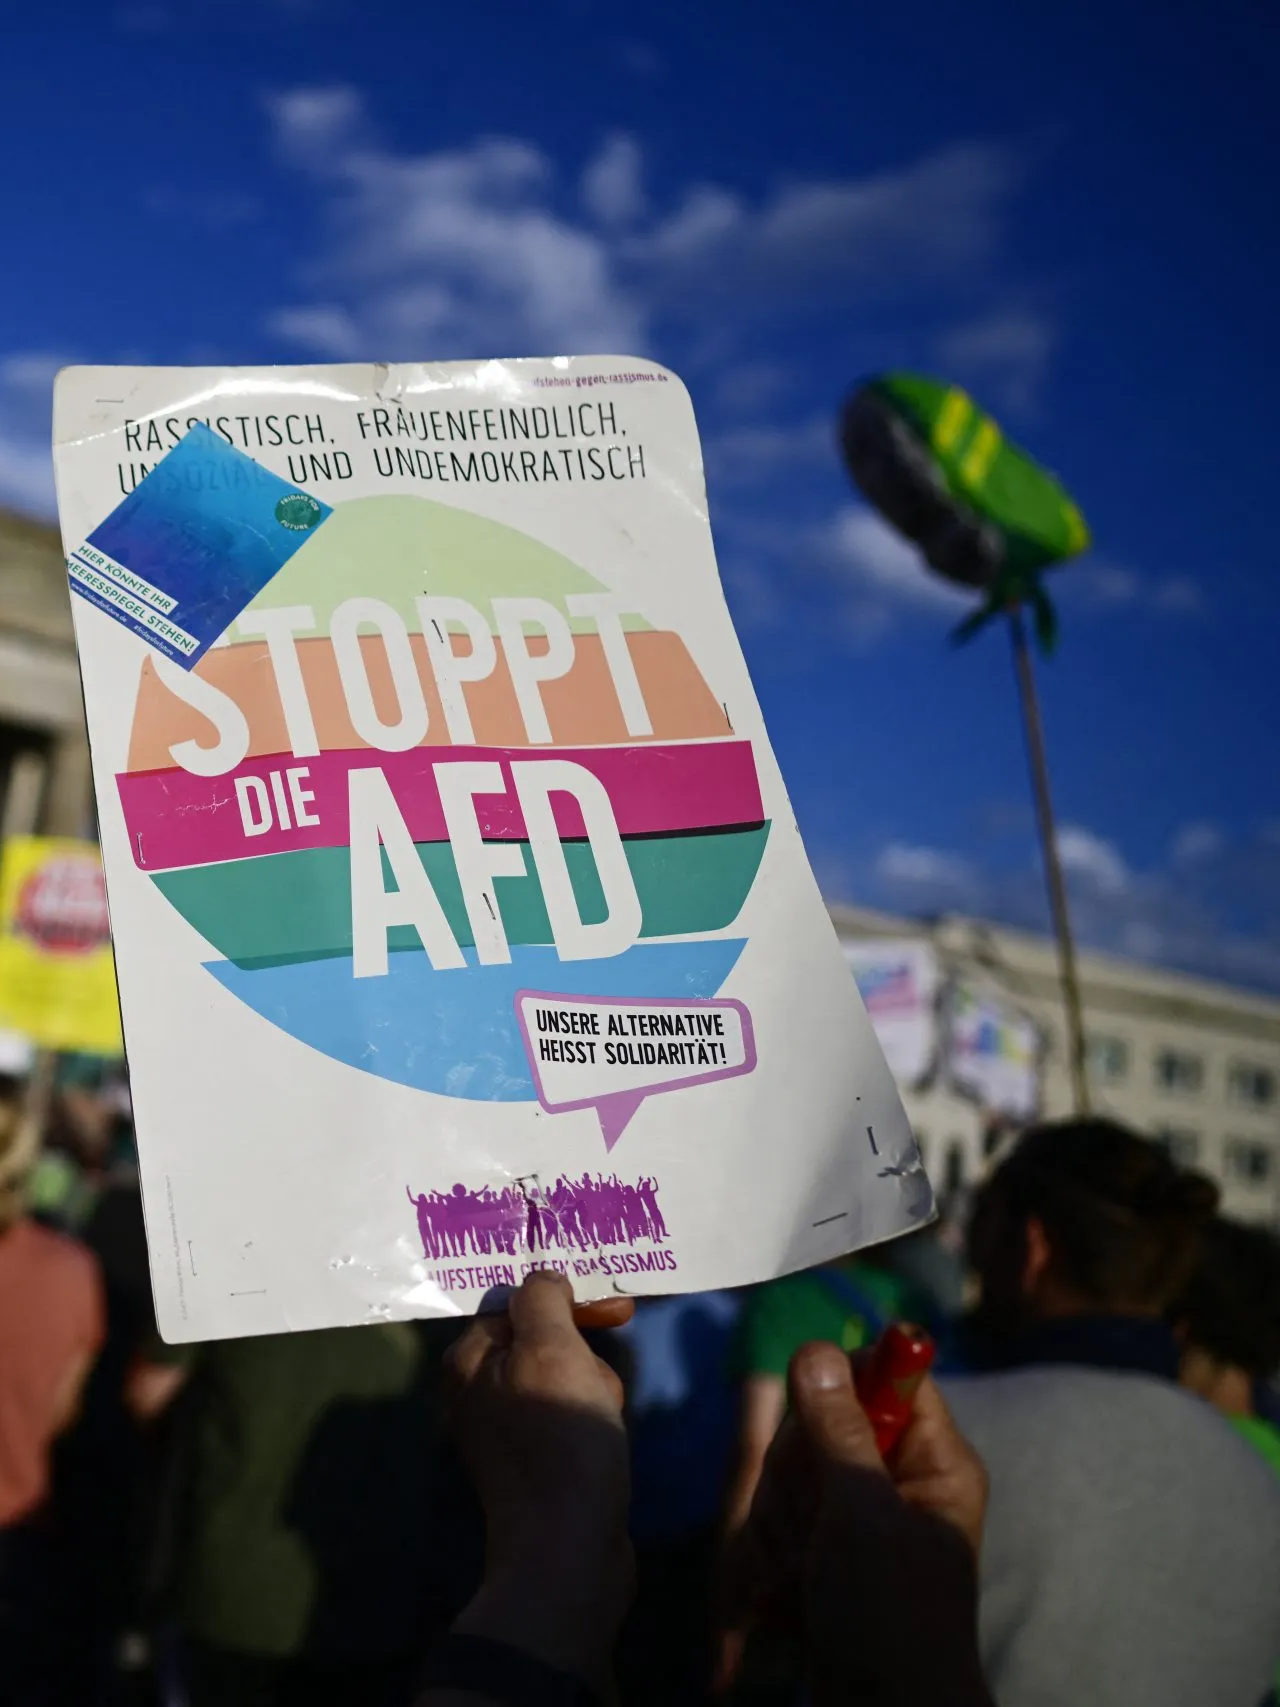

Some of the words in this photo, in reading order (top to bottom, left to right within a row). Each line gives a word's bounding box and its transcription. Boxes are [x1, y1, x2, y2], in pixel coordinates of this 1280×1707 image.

[124, 414, 335, 452] RASSISTISCH,
[357, 402, 627, 441] FRAUENFEINDLICH,
[288, 451, 354, 484] UND
[373, 445, 646, 482] UNDEMOKRATISCH
[78, 545, 105, 567] HIER
[105, 566, 151, 597] KÖNNTE
[150, 592, 172, 611] IHR
[133, 625, 174, 656] #fridaysforfuture
[147, 615, 195, 652] STEHEN!
[150, 592, 655, 777] STOPPT
[234, 766, 320, 837] DIE
[347, 759, 643, 979] AFD
[536, 1009, 600, 1036] UNSERE
[608, 1014, 725, 1036] ALTERNATIVE
[539, 1038, 597, 1064] HEISST
[605, 1038, 727, 1065] SOLIDARITÄT!
